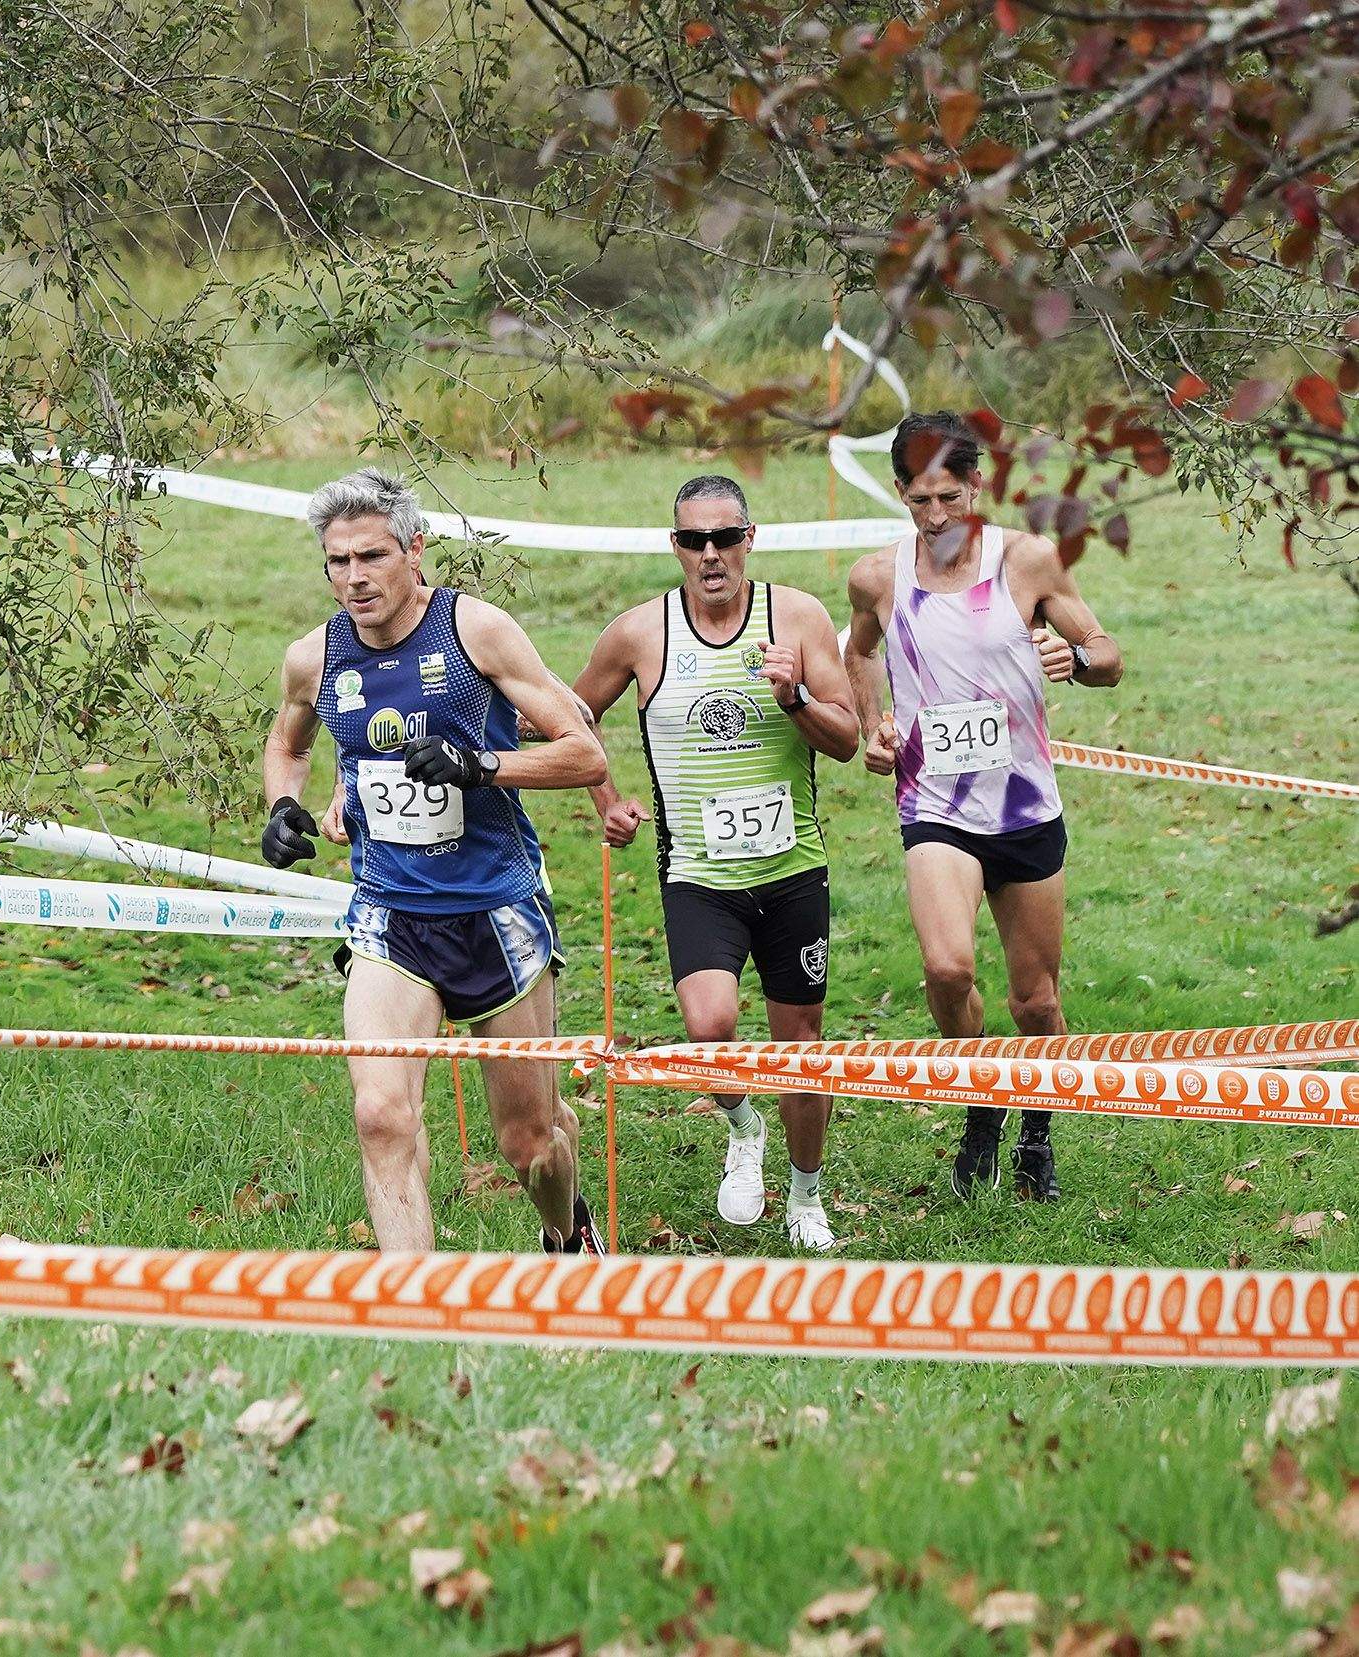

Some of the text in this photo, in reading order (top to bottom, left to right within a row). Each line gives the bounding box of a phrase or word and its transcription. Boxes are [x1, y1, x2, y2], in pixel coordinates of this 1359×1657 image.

[374, 711, 428, 747] Ulla Oil
[932, 717, 999, 752] 340
[369, 782, 449, 817] 329
[715, 800, 783, 841] 357
[425, 841, 459, 857] CERO
[7, 888, 38, 901] DEPORTE
[8, 903, 36, 915] GALEGO
[53, 905, 95, 918] DE GALICIA
[125, 910, 153, 922] GALEGO
[169, 912, 210, 925] DE GALICIA
[240, 916, 267, 927] GALEGO
[283, 917, 322, 928] DE GALICIA
